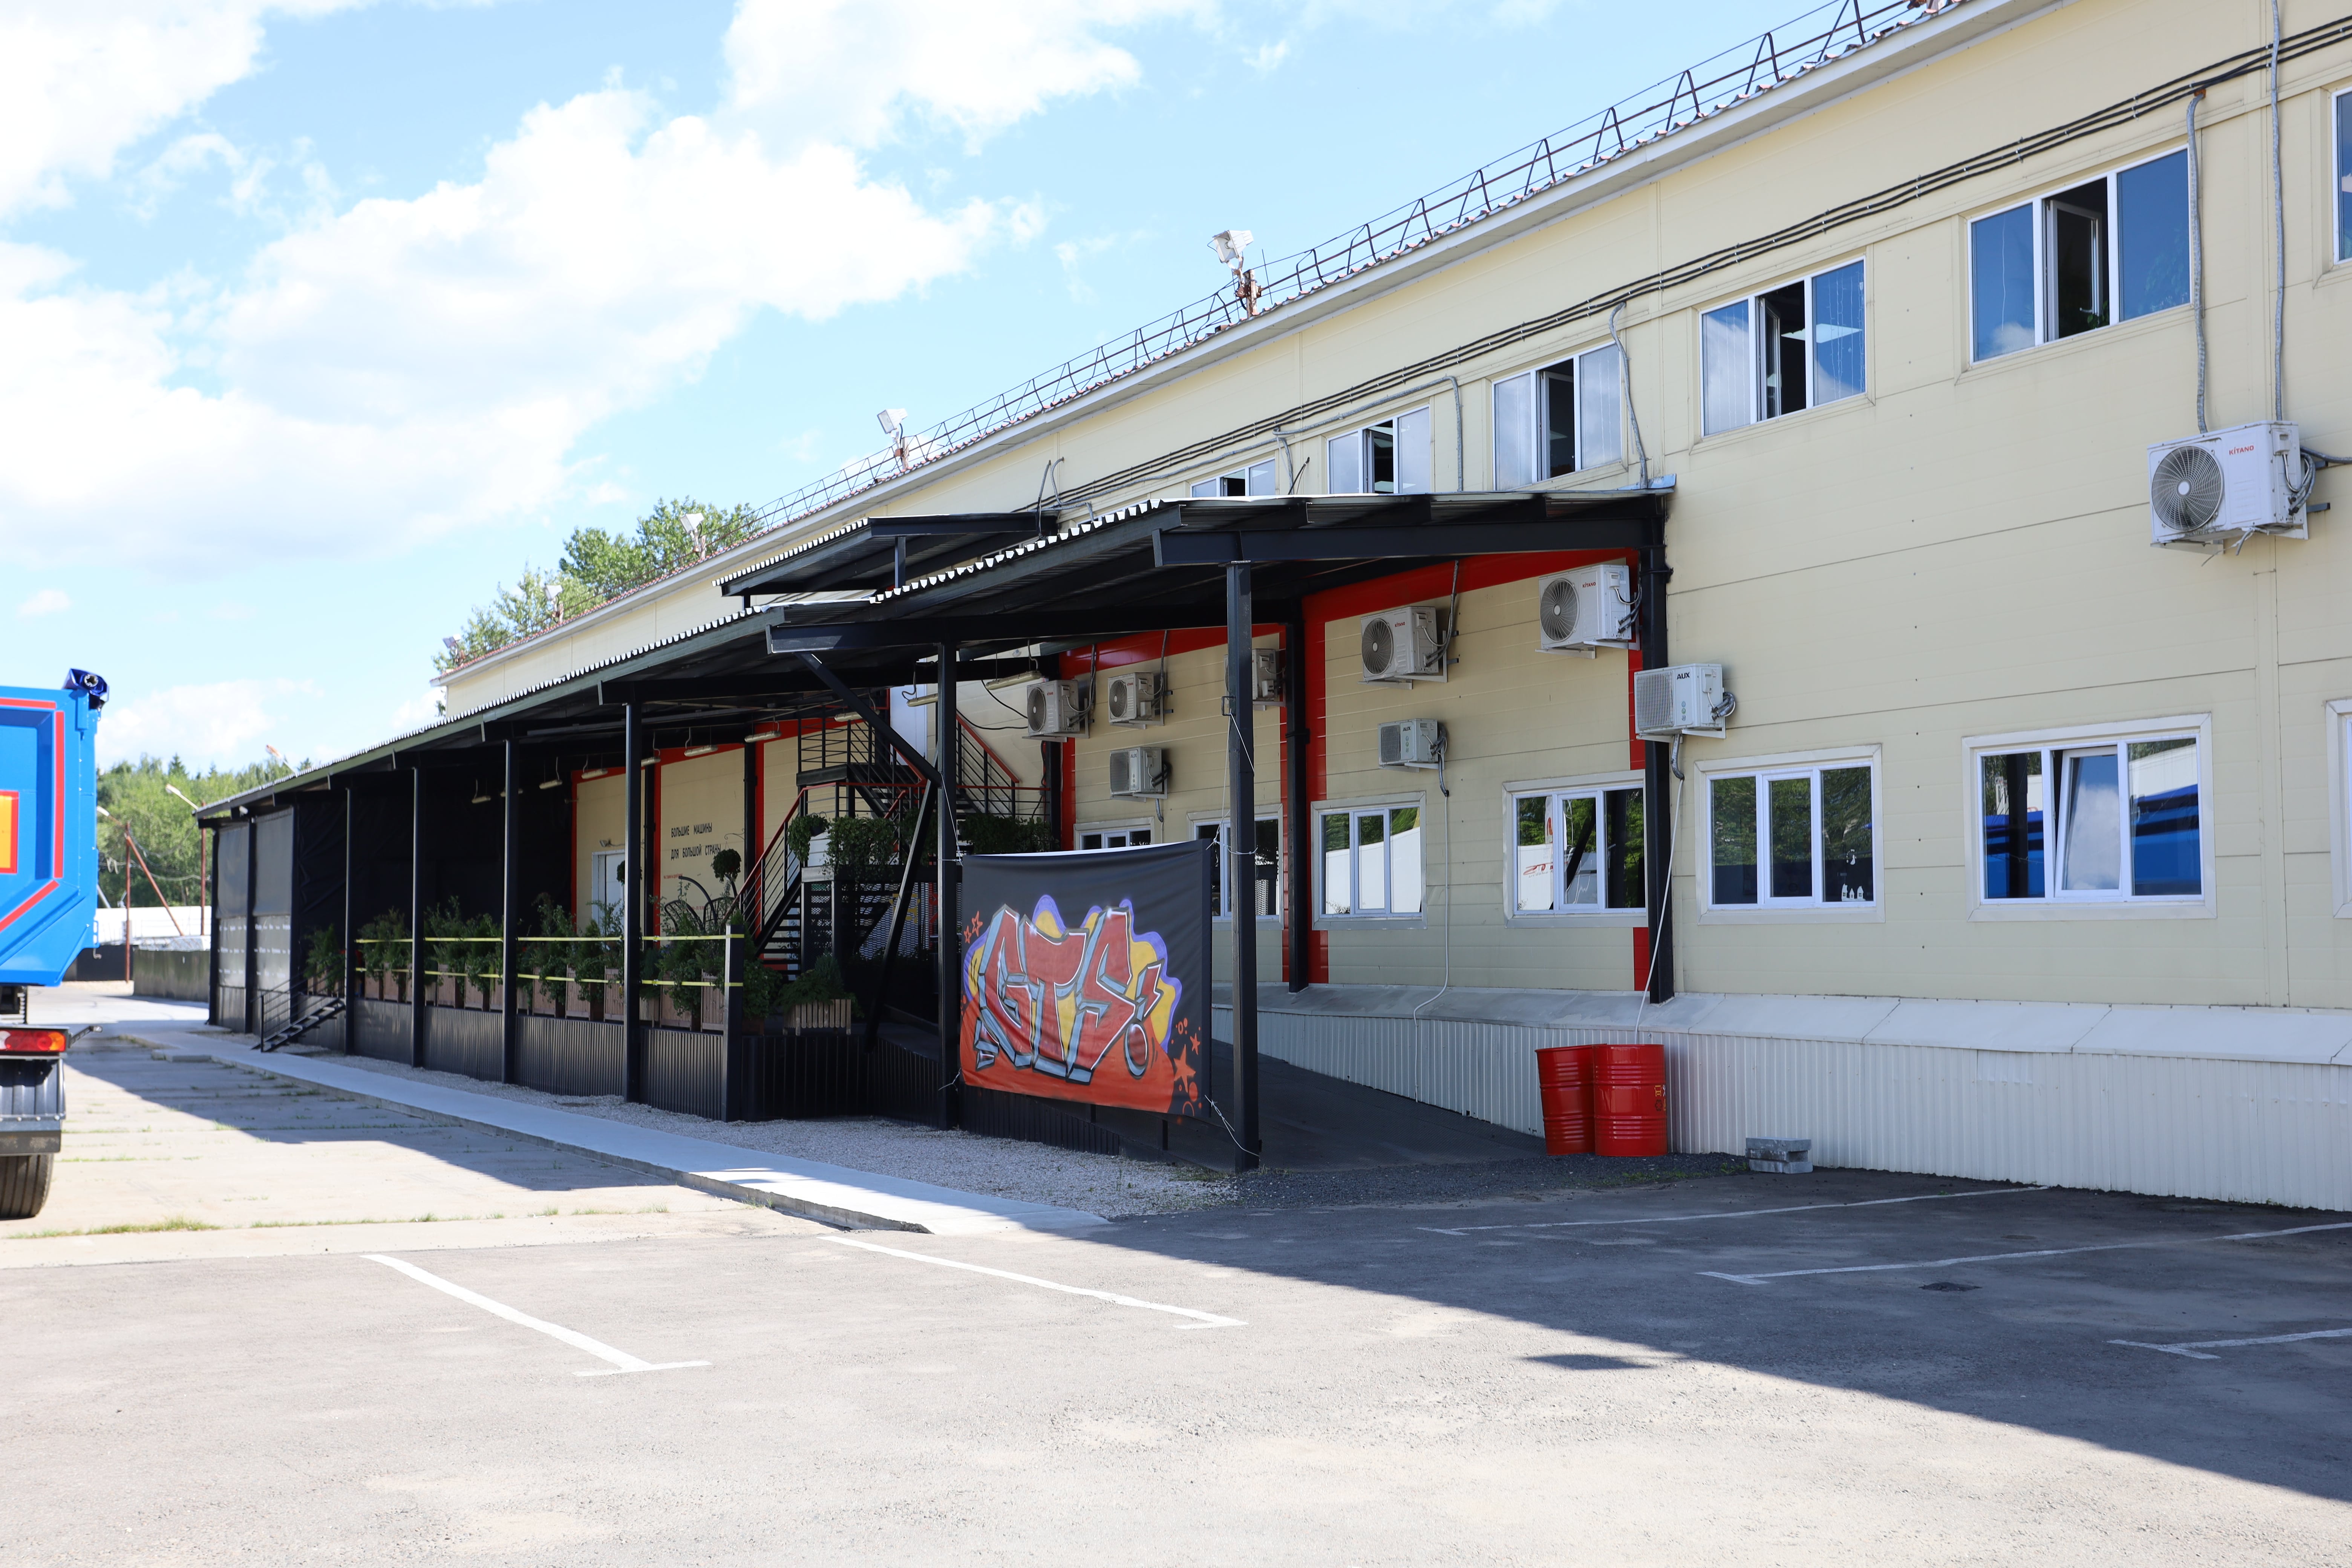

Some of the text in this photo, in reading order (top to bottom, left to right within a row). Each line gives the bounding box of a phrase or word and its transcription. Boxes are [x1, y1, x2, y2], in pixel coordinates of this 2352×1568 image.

[1677, 672, 1690, 680] AUX
[671, 822, 712, 838] БОЛЬШИЕ МАШИНЫ
[671, 844, 721, 861] ДЛЯ БОЛЬШОЙ СТРАНЫ
